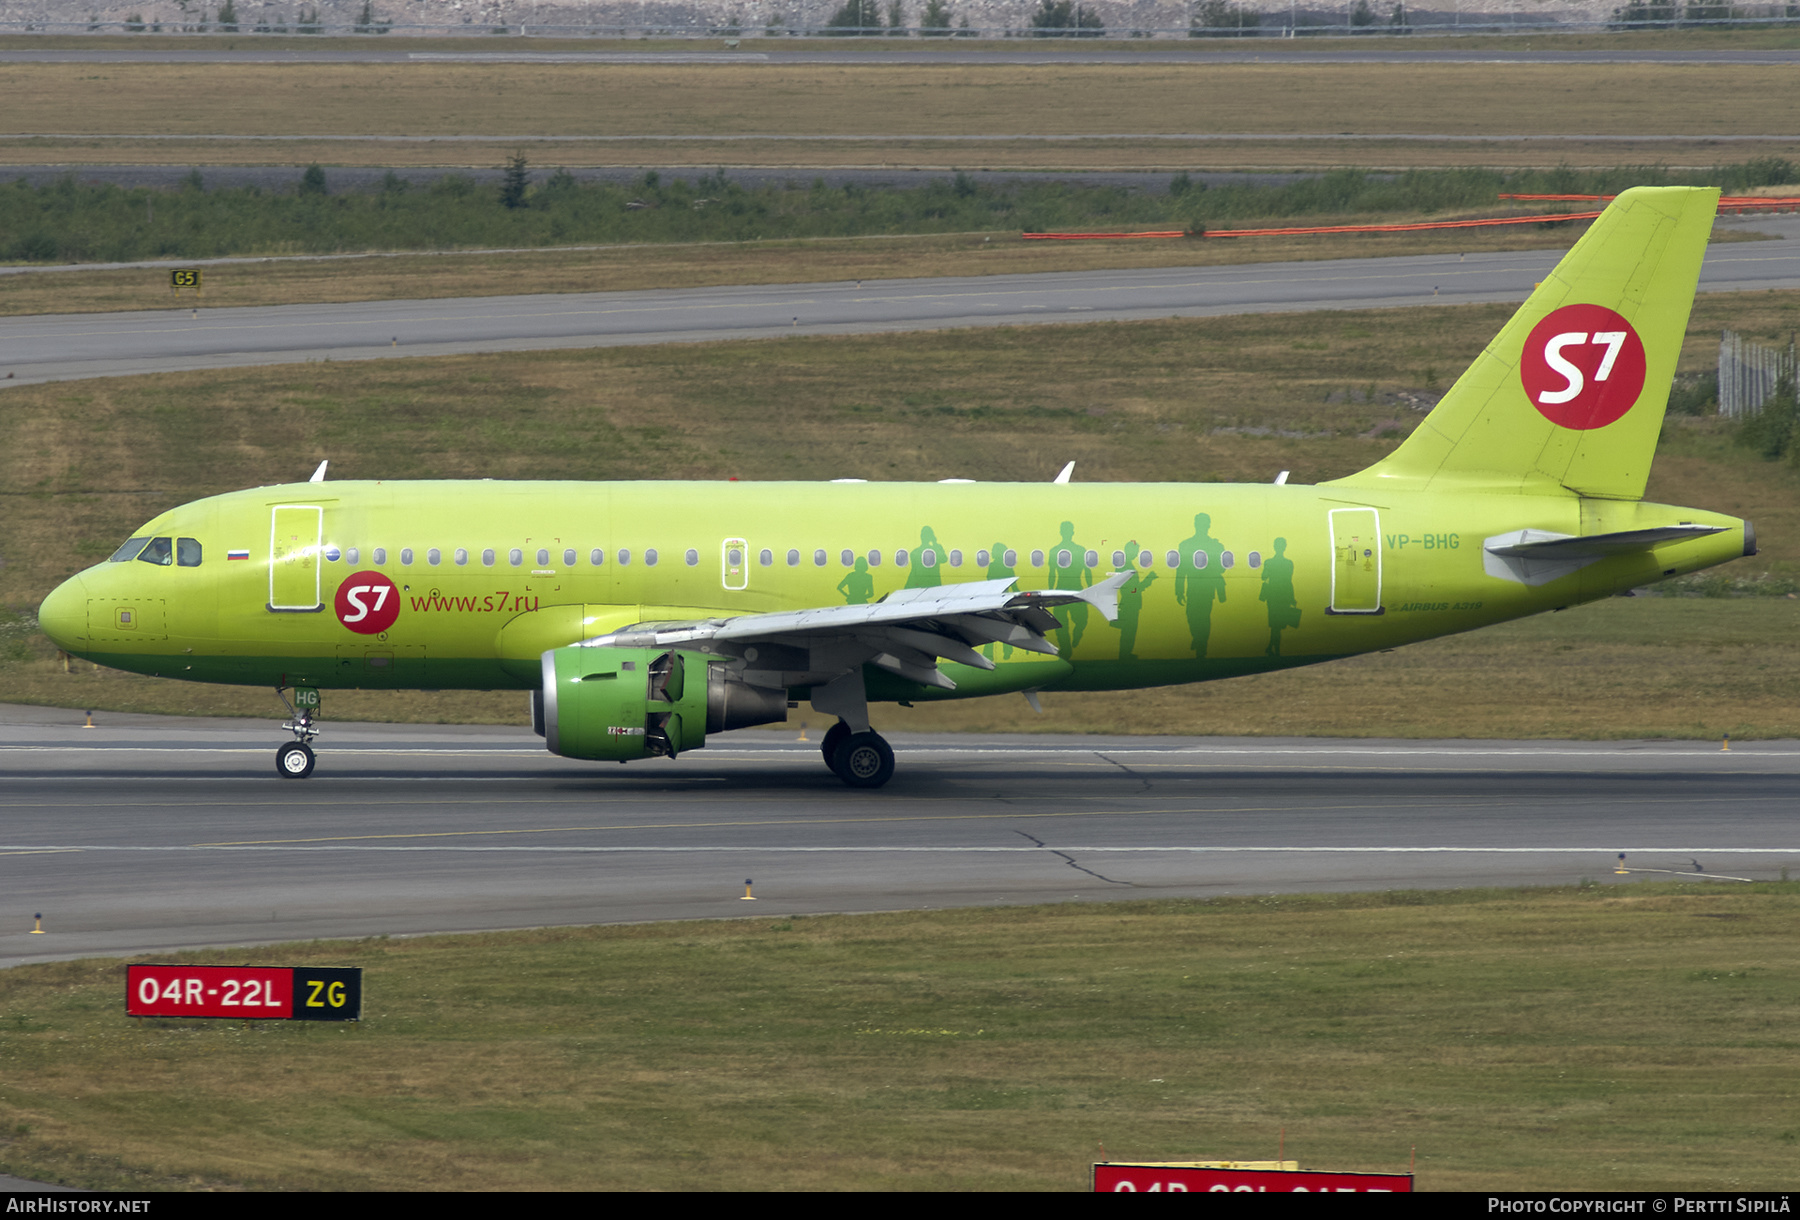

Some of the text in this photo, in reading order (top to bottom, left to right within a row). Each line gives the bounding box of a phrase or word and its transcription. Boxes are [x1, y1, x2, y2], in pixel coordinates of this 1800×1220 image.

[175, 271, 195, 285] G5
[1538, 331, 1627, 404] S7
[1386, 533, 1460, 550] VP-BHG
[343, 585, 391, 622] S7
[410, 591, 539, 612] www.s7.ru
[1400, 601, 1483, 612] AIRBUS A319
[296, 691, 317, 705] HG
[138, 977, 347, 1008] 04R-22L ZG
